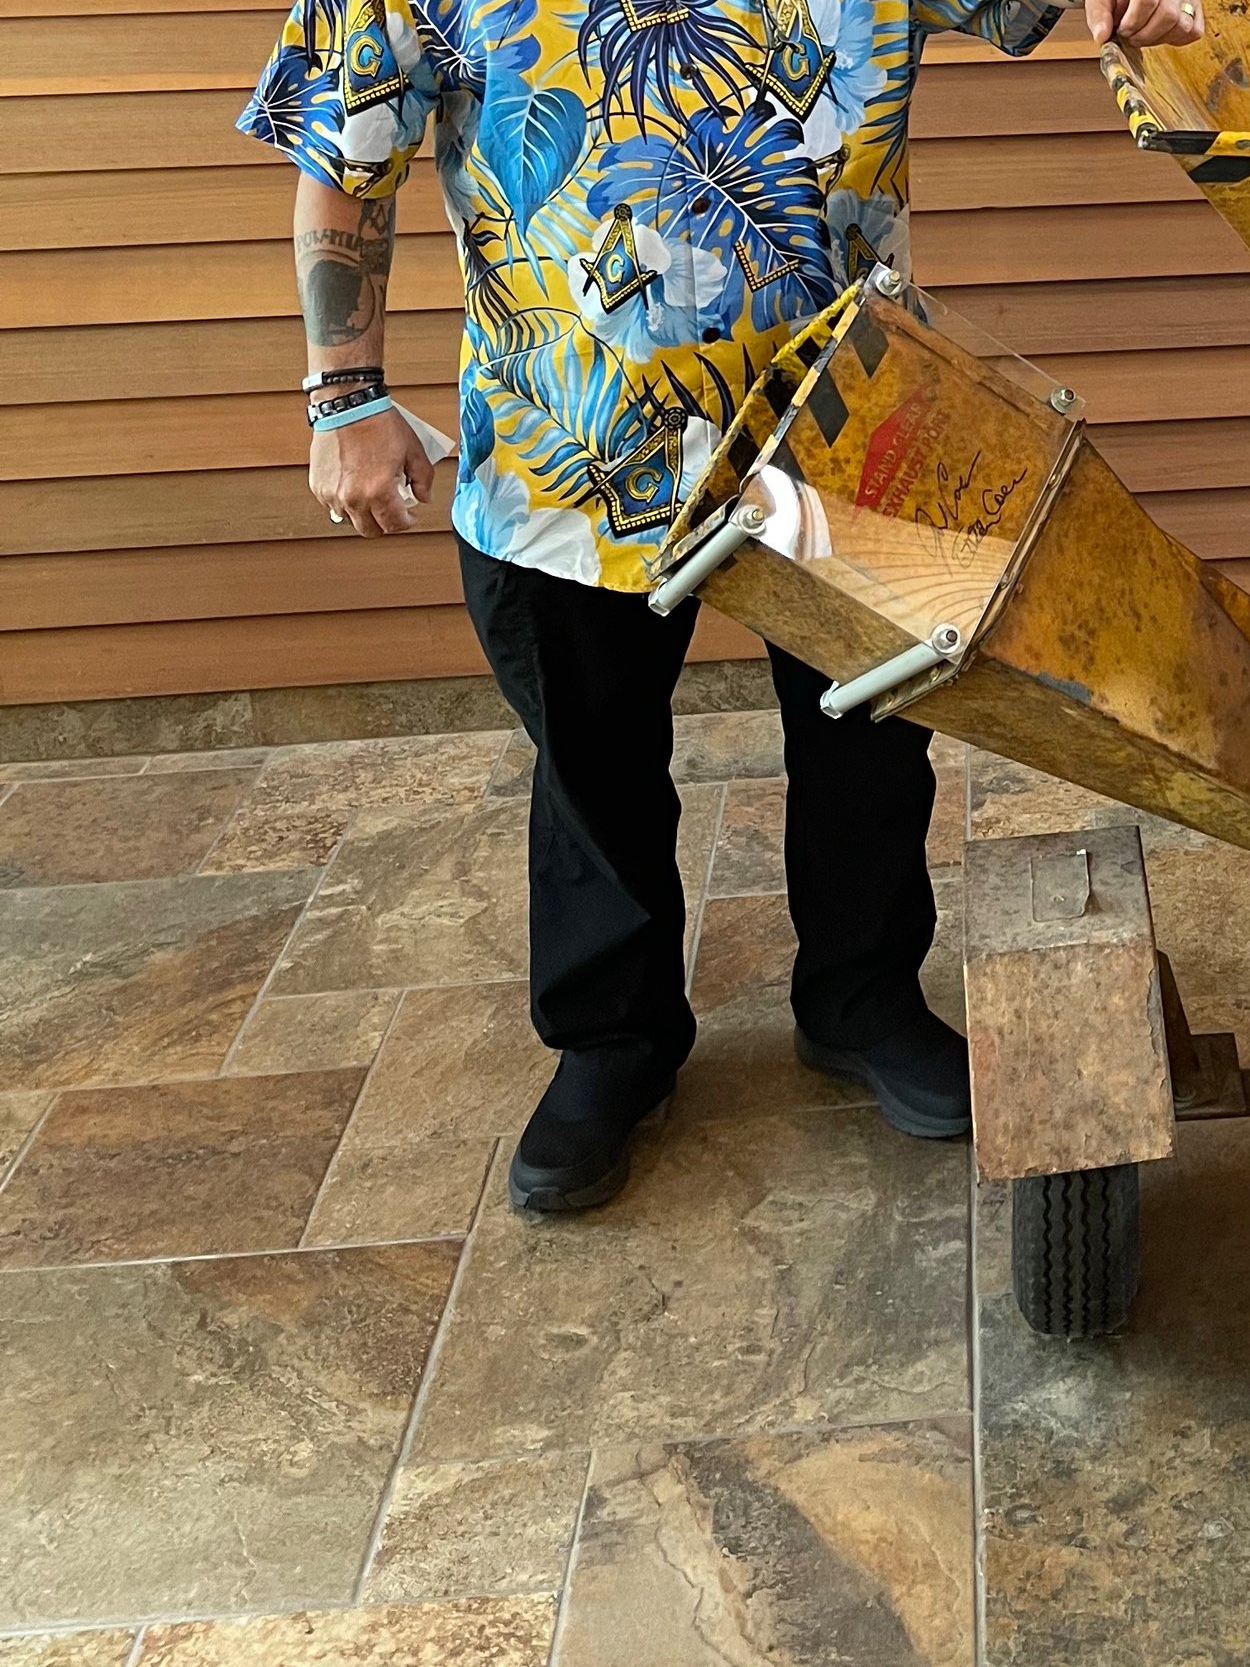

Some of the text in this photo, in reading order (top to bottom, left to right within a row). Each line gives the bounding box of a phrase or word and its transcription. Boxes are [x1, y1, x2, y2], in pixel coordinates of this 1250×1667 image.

[865, 402, 922, 497] STAND CLEAR
[921, 409, 949, 450] PORT
